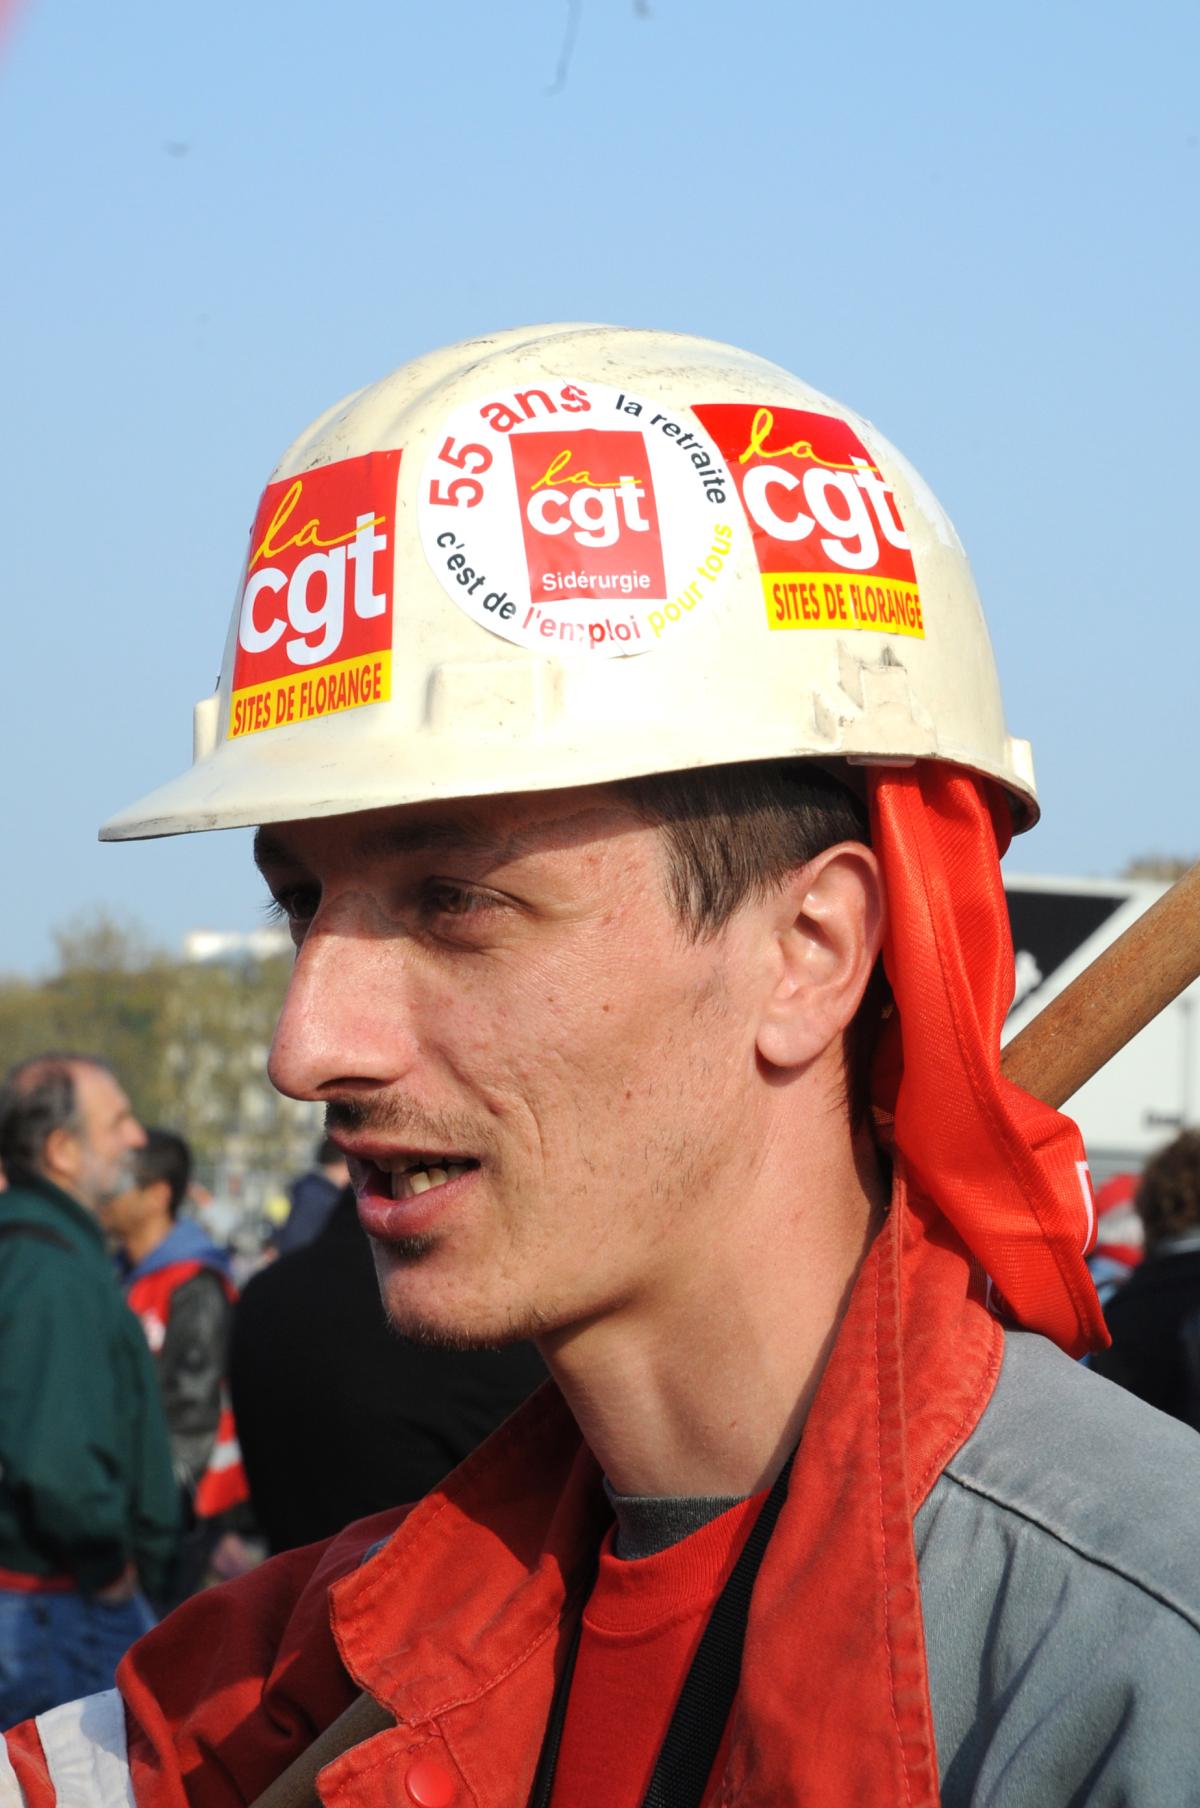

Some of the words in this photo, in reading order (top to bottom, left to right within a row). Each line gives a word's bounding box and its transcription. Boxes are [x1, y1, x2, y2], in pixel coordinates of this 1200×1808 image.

[429, 436, 493, 508] 55
[479, 384, 592, 433] ans
[531, 450, 642, 491] la
[614, 394, 643, 417] la
[650, 413, 727, 504] retraite
[739, 408, 878, 464] la
[248, 480, 386, 572] la
[527, 476, 650, 548] cgt
[743, 454, 912, 570] cgt
[239, 511, 387, 666] cgt
[436, 531, 486, 595] c'est
[482, 591, 517, 620] de
[647, 581, 704, 637] pour
[697, 522, 733, 582] tous
[542, 570, 651, 593] Sidérurgie
[773, 583, 820, 621] SITES
[823, 583, 847, 620] DE
[849, 584, 923, 630] FLORANGE
[233, 691, 271, 736] SITES
[275, 684, 295, 725] DE
[299, 662, 382, 718] FLORANGE
